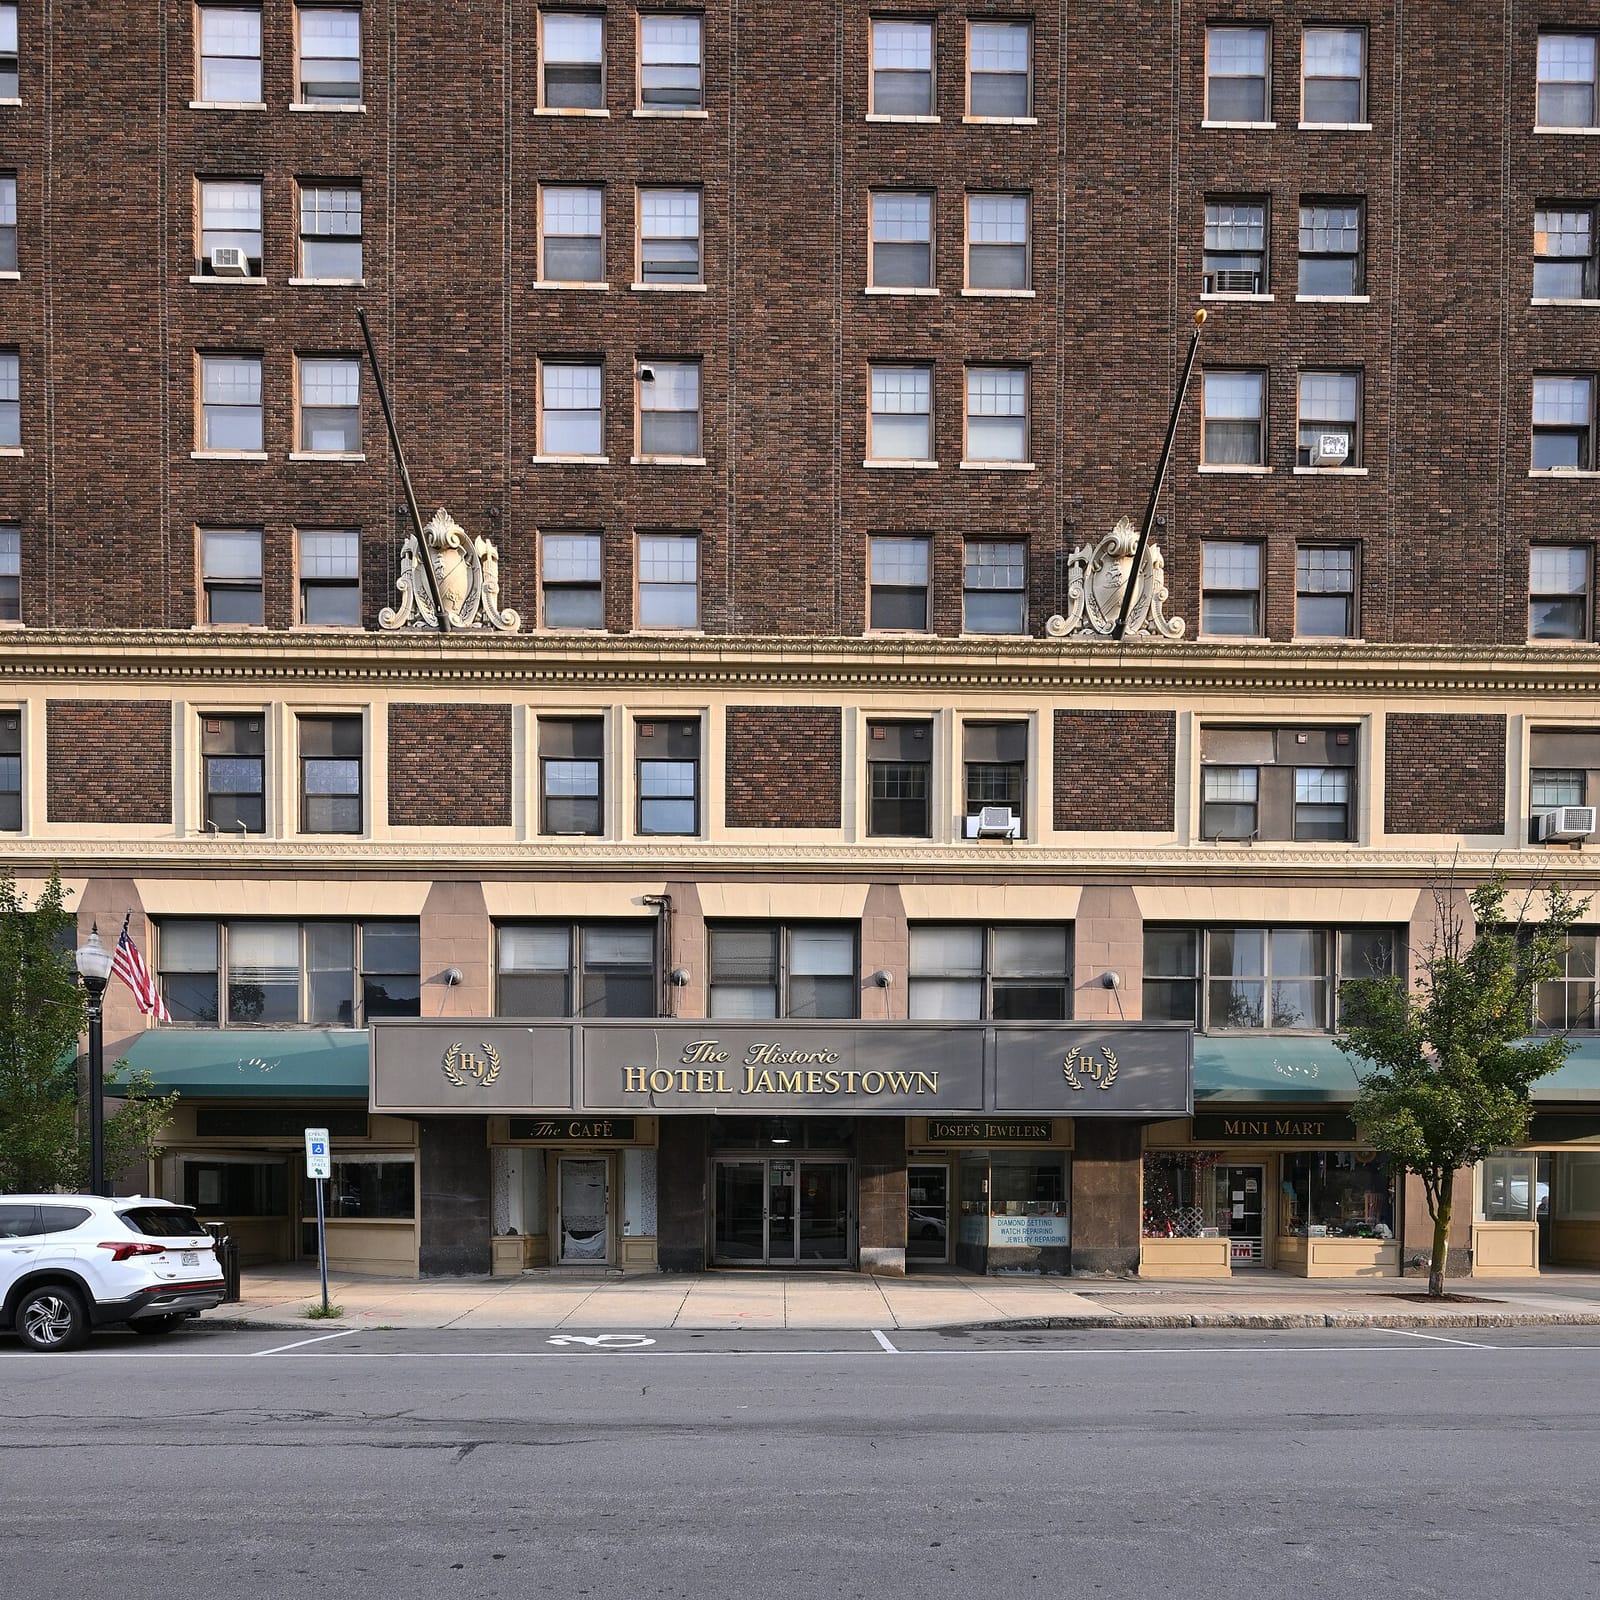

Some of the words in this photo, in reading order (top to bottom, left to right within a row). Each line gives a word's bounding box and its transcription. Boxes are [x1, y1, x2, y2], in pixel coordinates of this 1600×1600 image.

[682, 1040, 730, 1063] The
[744, 1043, 841, 1065] Historic
[623, 1066, 733, 1093] HOTEL
[740, 1066, 939, 1095] JAMESTOWN
[530, 1122, 561, 1136] The
[934, 1123, 980, 1138] JOSEF'S
[984, 1123, 1047, 1138] JEWELERS
[1223, 1119, 1269, 1135] MINI
[1274, 1119, 1325, 1135] MART
[997, 1219, 1026, 1227] DIAMOND
[1027, 1219, 1053, 1227] SETTING
[1231, 1248, 1251, 1257] TM
